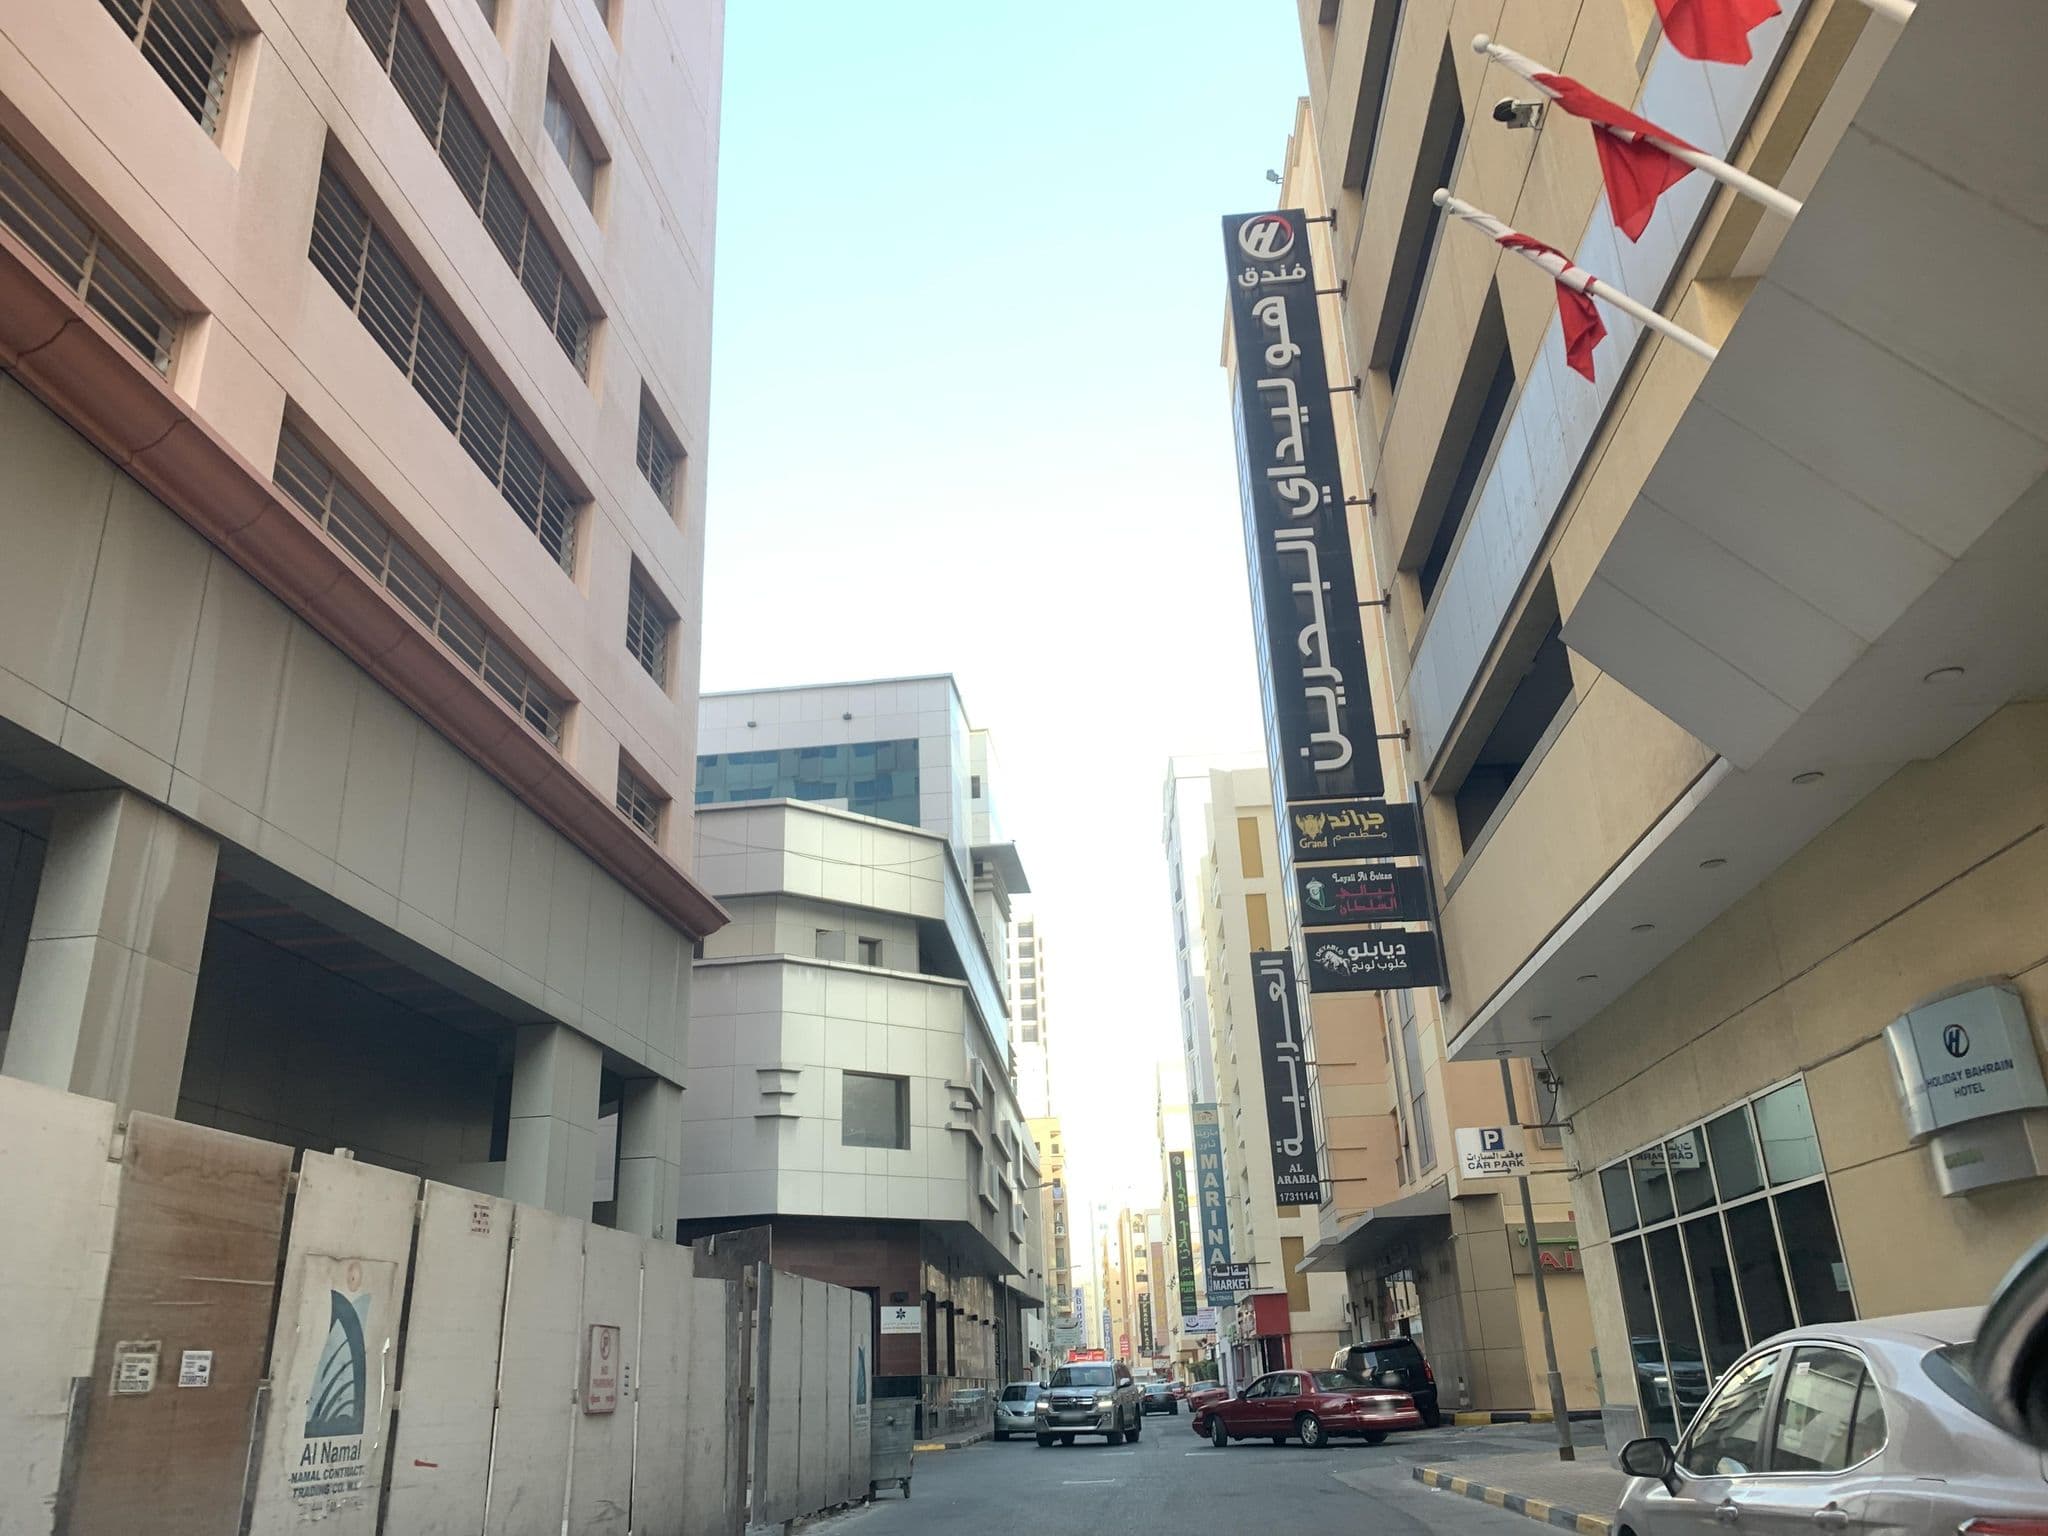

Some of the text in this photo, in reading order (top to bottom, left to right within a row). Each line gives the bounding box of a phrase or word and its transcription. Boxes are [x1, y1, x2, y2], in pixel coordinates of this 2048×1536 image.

[1238, 263, 1307, 288] فندق
[1274, 527, 1353, 772] البحرين
[1327, 810, 1385, 832] جراند
[1299, 836, 1328, 849] Grand
[1333, 828, 1388, 848] مطعم
[1348, 941, 1406, 961] ديابلو
[1351, 958, 1408, 973] كلوب لونج
[1260, 959, 1305, 1157] العربية
[1926, 1058, 2014, 1088] HOLIDAY BAHRAIN
[1953, 1083, 1985, 1098] HOTEL
[1484, 1130, 1499, 1149] P
[1466, 1150, 1523, 1162] موقف السيارات
[1468, 1159, 1525, 1170] CAR PARK
[1289, 1163, 1304, 1173] AL
[1277, 1174, 1318, 1185] ARABIA
[1280, 1191, 1319, 1202] 17311141
[1200, 1153, 1227, 1265] MARINA
[1211, 1264, 1249, 1279] بقالة
[1213, 1278, 1249, 1291] MARKET
[300, 1439, 362, 1466] Al Namal
